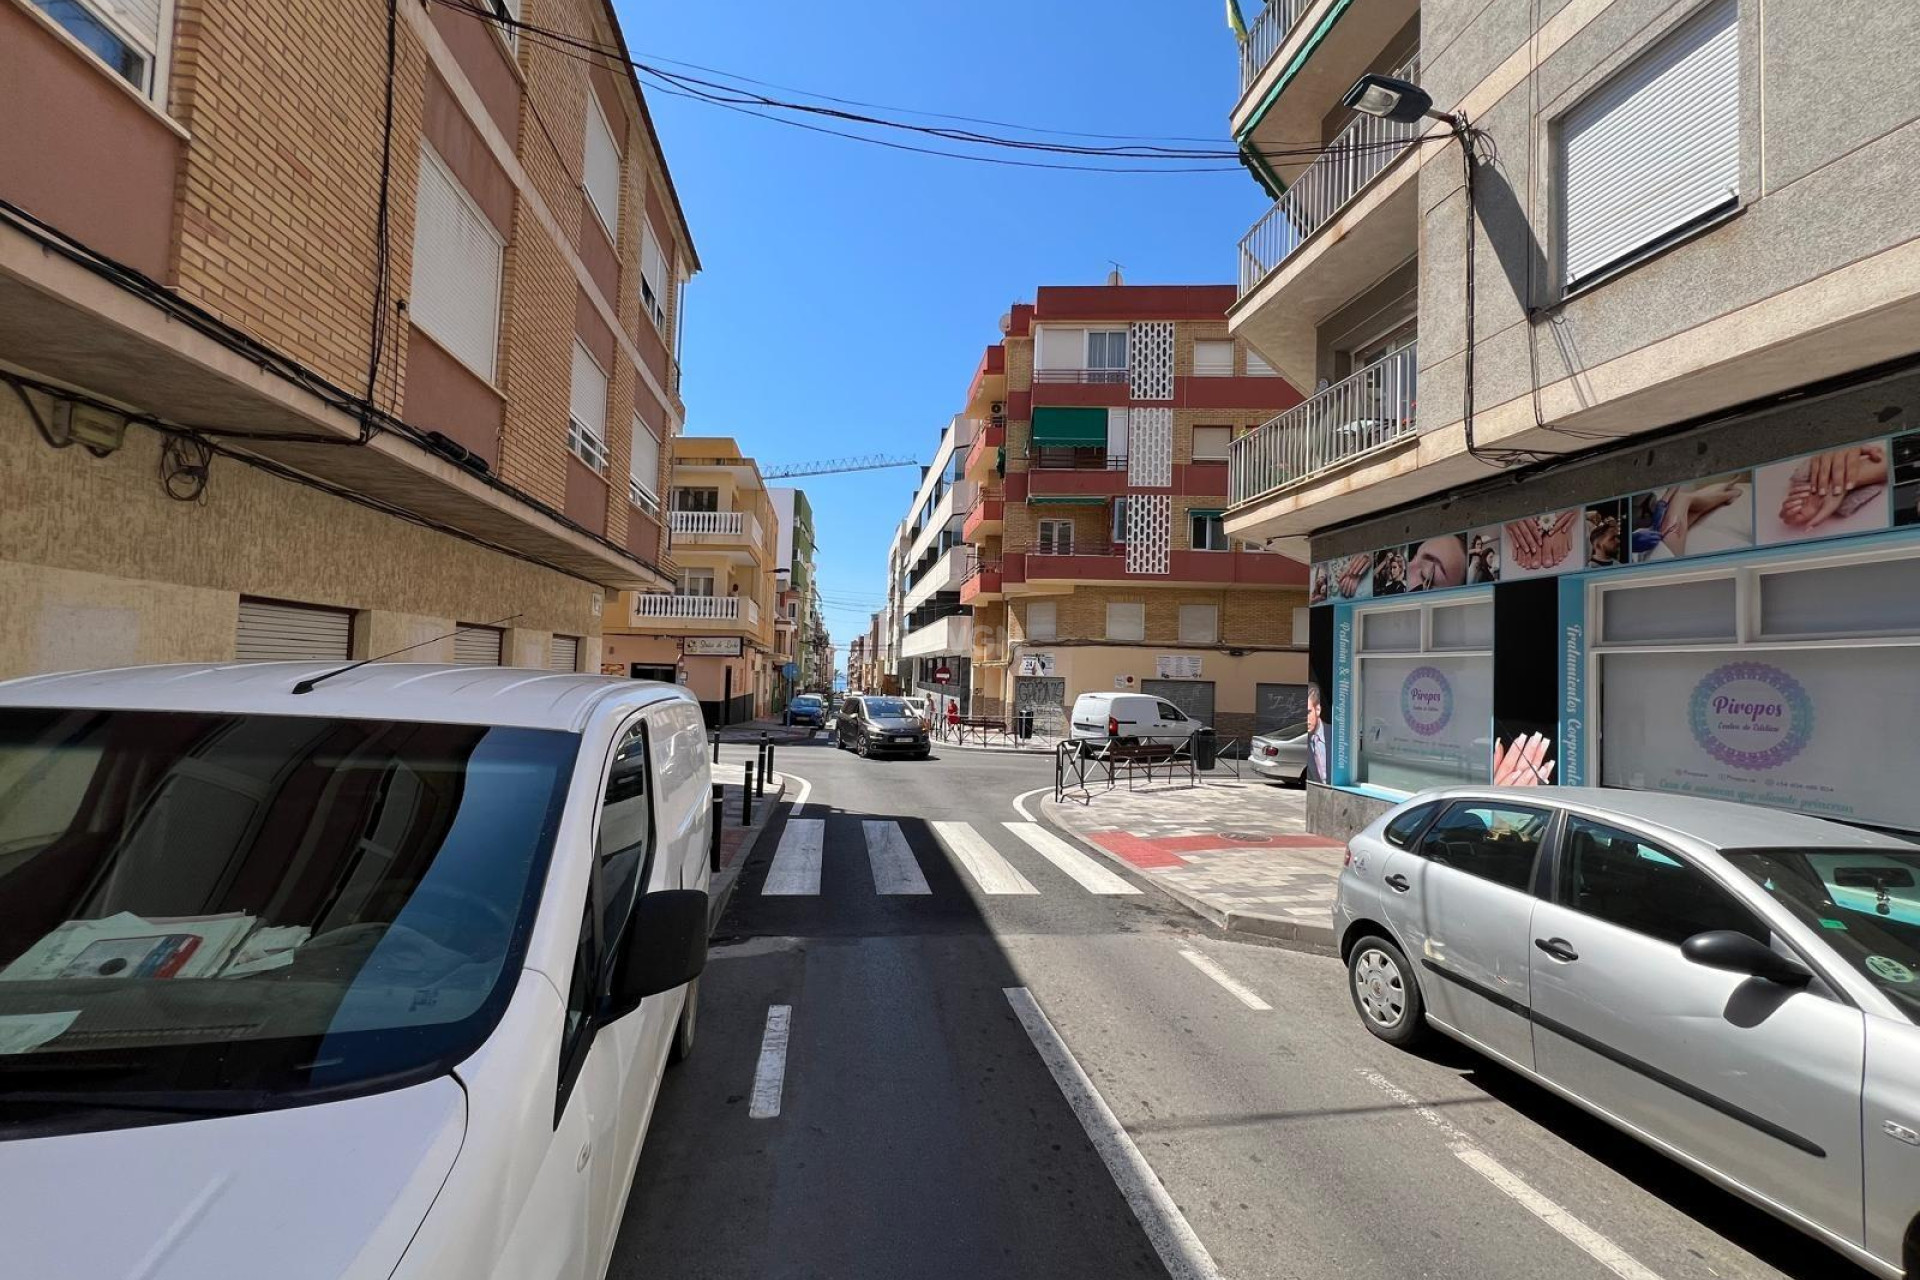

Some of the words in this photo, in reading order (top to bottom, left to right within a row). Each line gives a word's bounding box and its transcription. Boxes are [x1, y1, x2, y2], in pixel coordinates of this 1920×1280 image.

[1338, 666, 1349, 676] &
[1566, 624, 1582, 713] Tratamientos
[1411, 687, 1441, 705] Piropos
[1713, 695, 1783, 721] Piropos
[1718, 721, 1740, 731] Centro
[1742, 722, 1751, 731] de
[1562, 719, 1582, 786] Corporale
